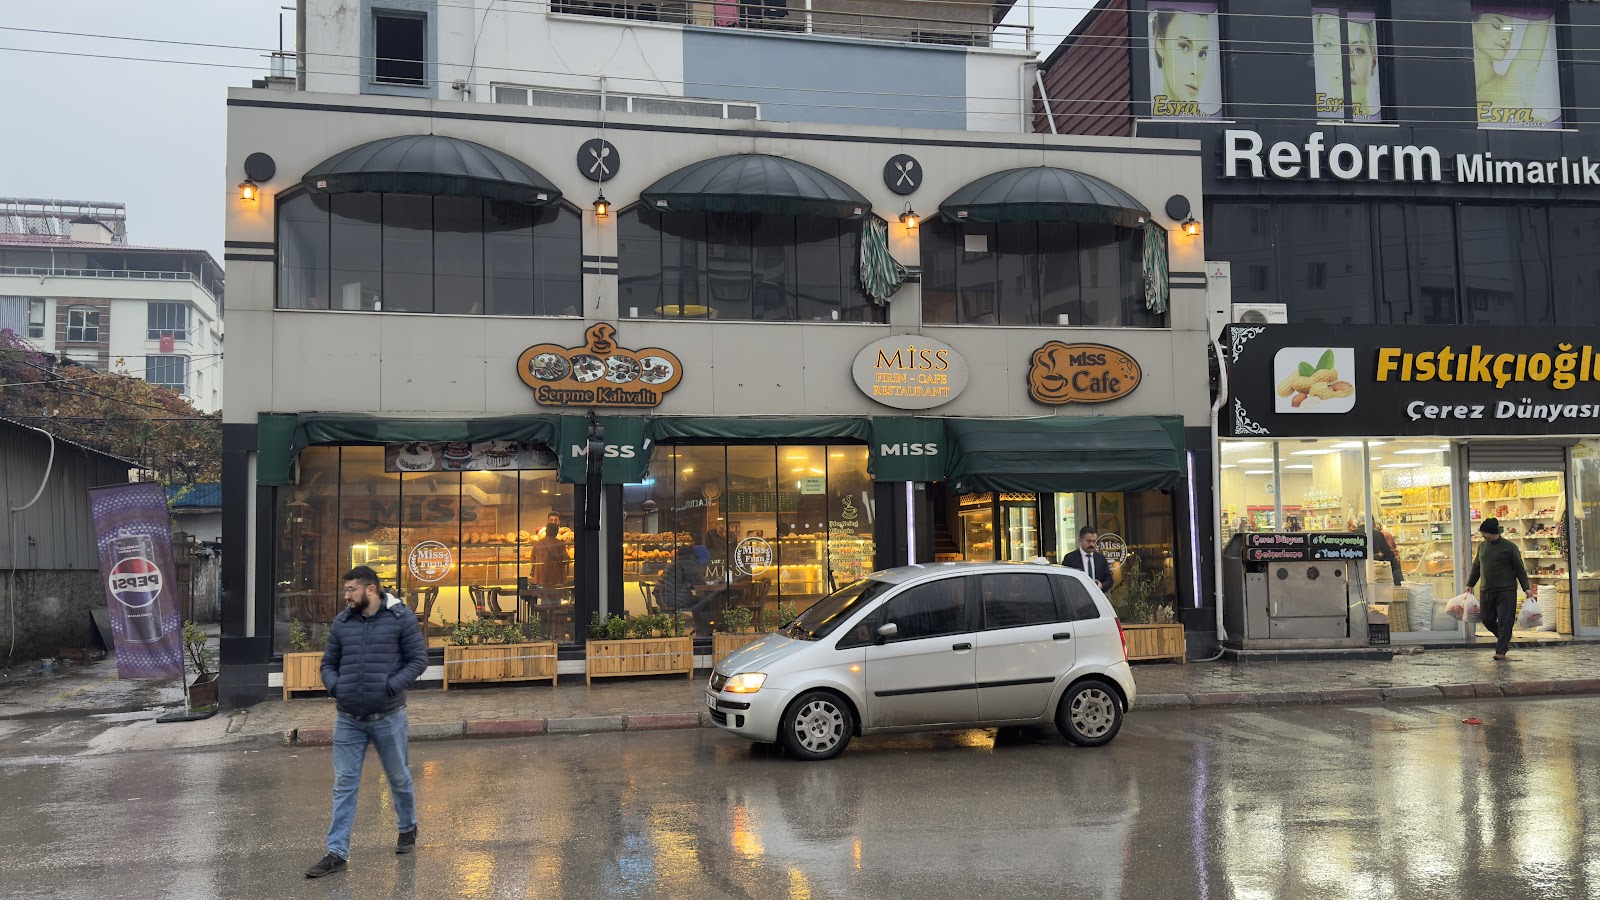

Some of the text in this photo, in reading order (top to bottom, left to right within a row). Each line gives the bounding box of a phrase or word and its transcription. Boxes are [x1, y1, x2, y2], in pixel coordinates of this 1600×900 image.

[1153, 95, 1200, 116] Esra
[1476, 101, 1534, 123] Esra
[1224, 129, 1600, 185] Reform Mimarlık
[917, 374, 948, 385] CAFE
[1072, 370, 1121, 393] Cafe
[539, 386, 594, 405] Serpme
[873, 385, 950, 397] RESTAURANT
[1407, 397, 1600, 422] Çerez Dünyası
[571, 444, 636, 458] MSS
[742, 545, 766, 555] Miss
[1100, 541, 1121, 550] Miss
[418, 550, 444, 559] Miss
